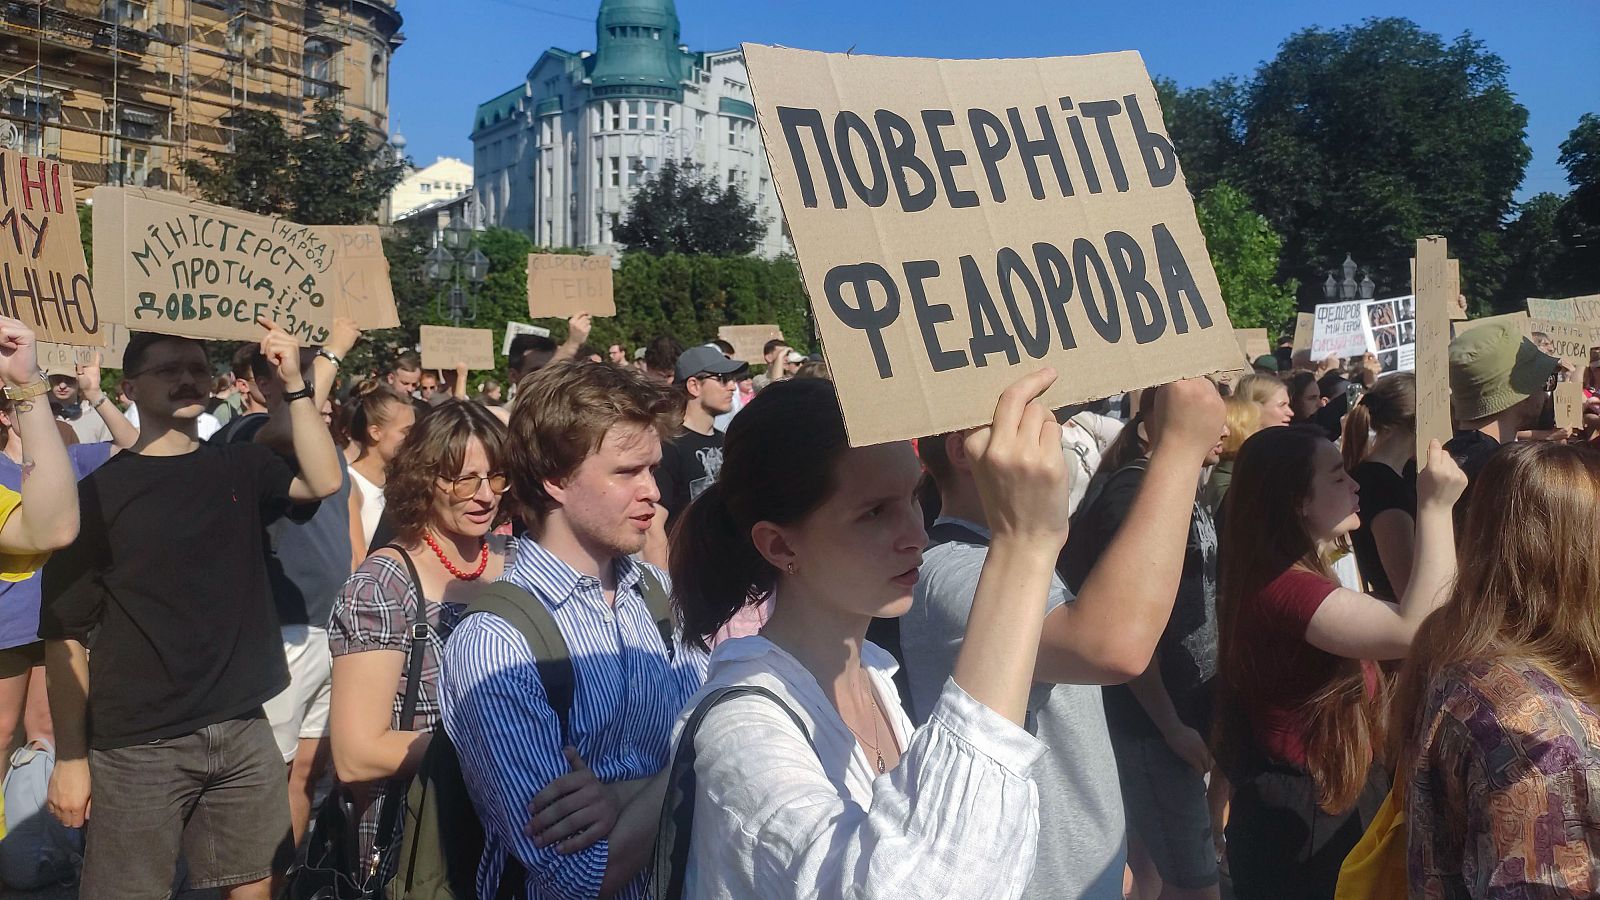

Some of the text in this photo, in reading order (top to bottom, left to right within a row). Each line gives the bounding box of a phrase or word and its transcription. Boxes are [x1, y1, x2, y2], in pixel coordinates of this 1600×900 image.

[0, 263, 98, 335] ННЮ
[824, 223, 1213, 379] ФЕДОРОВА
[1317, 303, 1361, 324] ФЕДОРОВ
